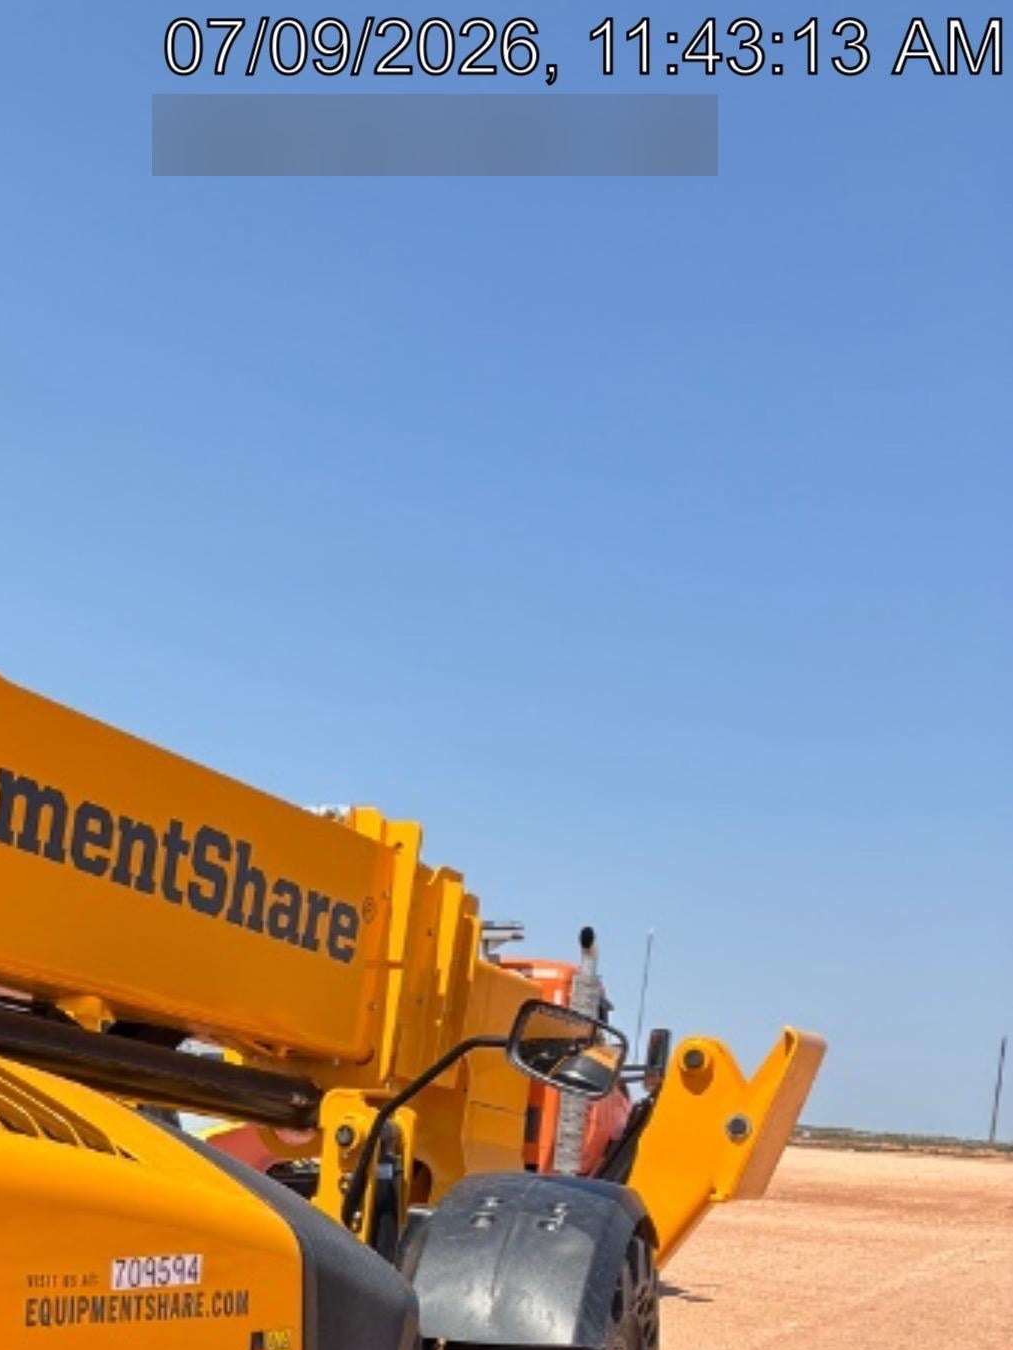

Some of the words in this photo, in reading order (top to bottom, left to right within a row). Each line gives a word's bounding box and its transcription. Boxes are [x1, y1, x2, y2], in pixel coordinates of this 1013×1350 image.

[27, 1274, 57, 1288] VISIT
[115, 1256, 198, 1288] 709594
[25, 1290, 249, 1327] EQUIPMENTSHARE.COM
